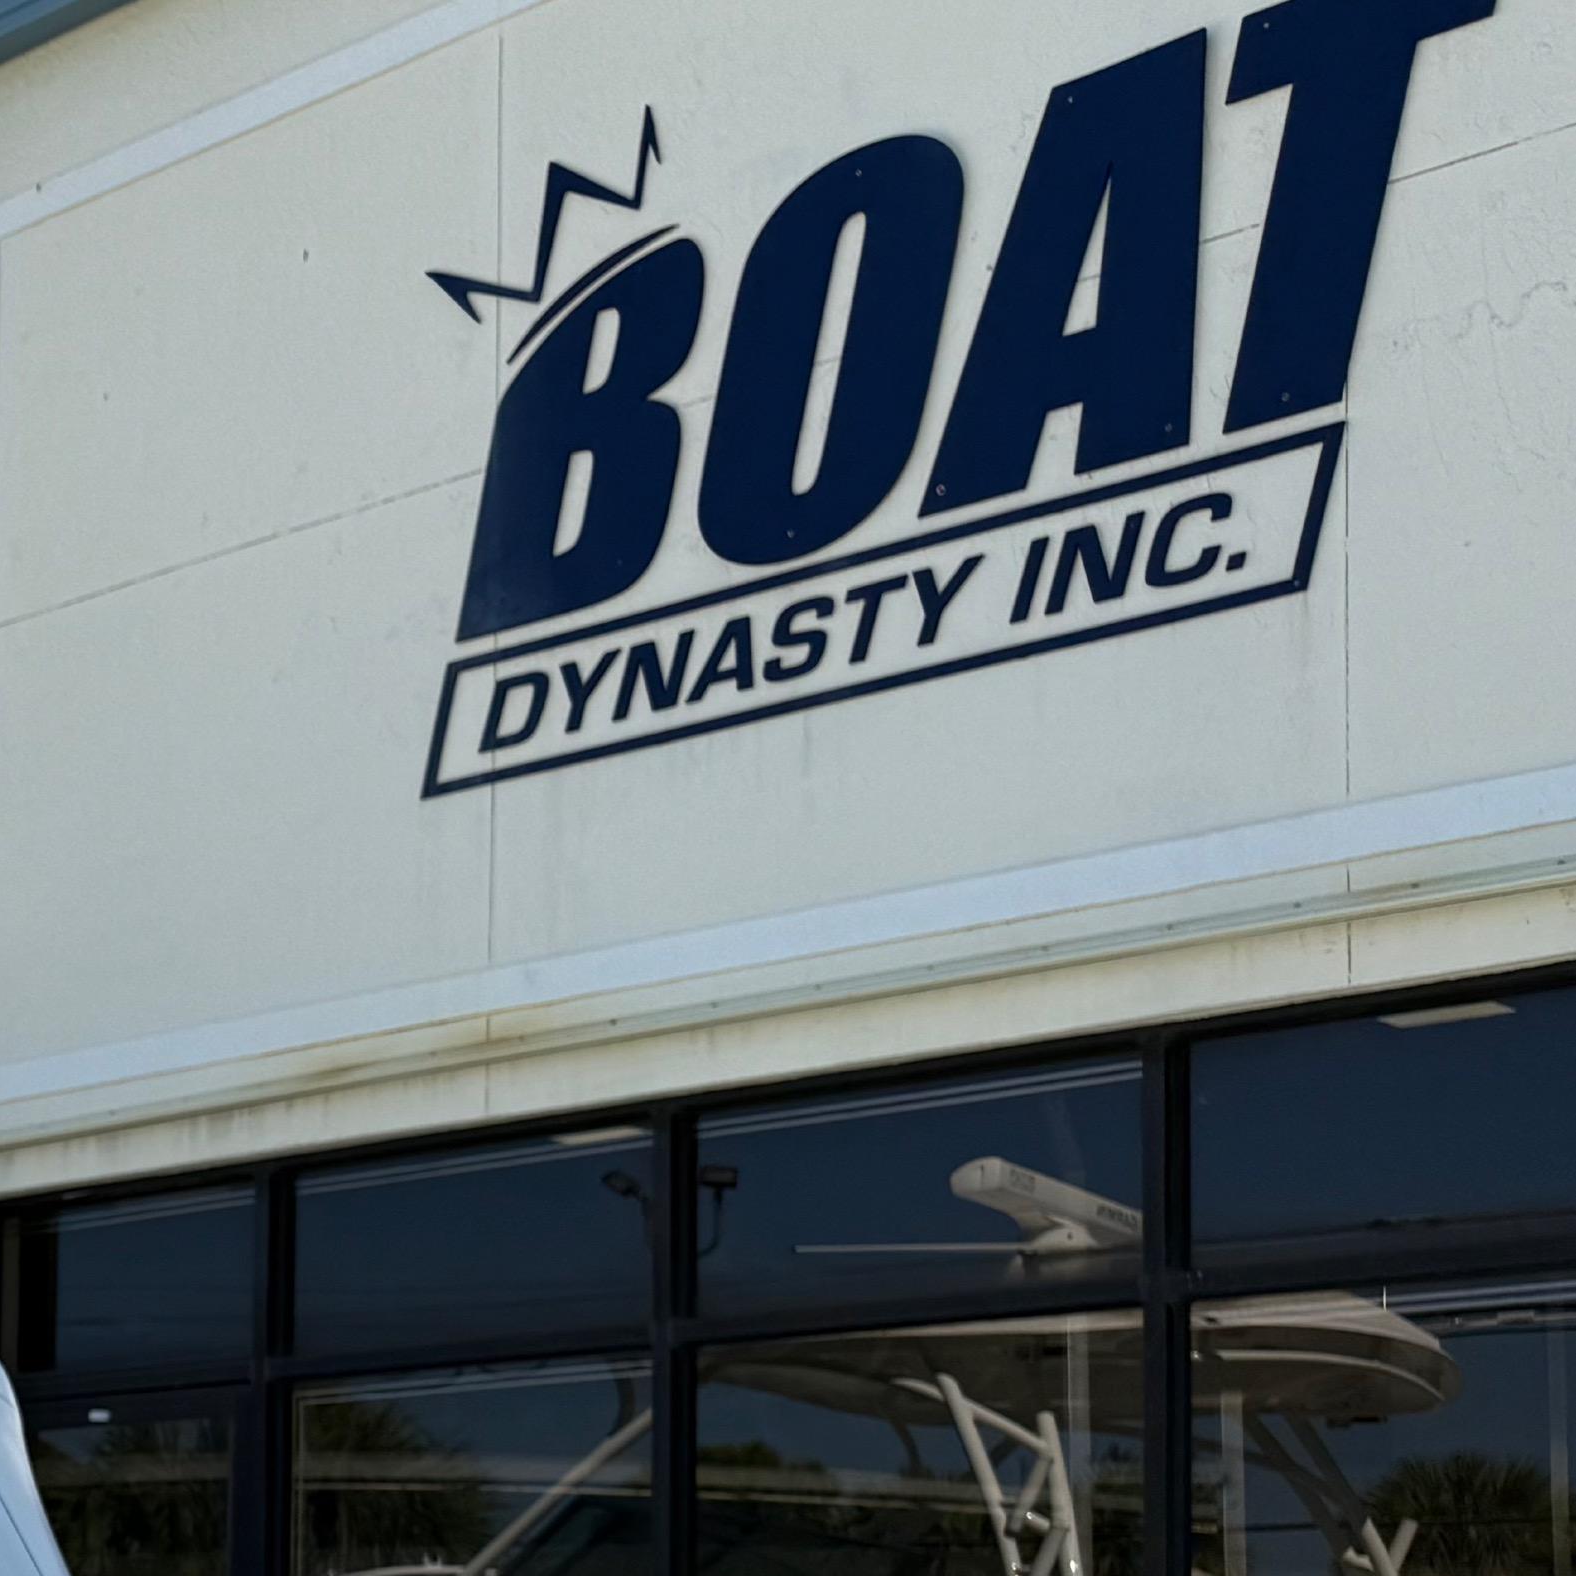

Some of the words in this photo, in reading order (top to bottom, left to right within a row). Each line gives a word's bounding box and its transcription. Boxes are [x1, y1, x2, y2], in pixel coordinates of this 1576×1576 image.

[455, 0, 1497, 642] BOAT
[478, 554, 984, 754] DYNASTY
[1009, 491, 1249, 625] INC.
